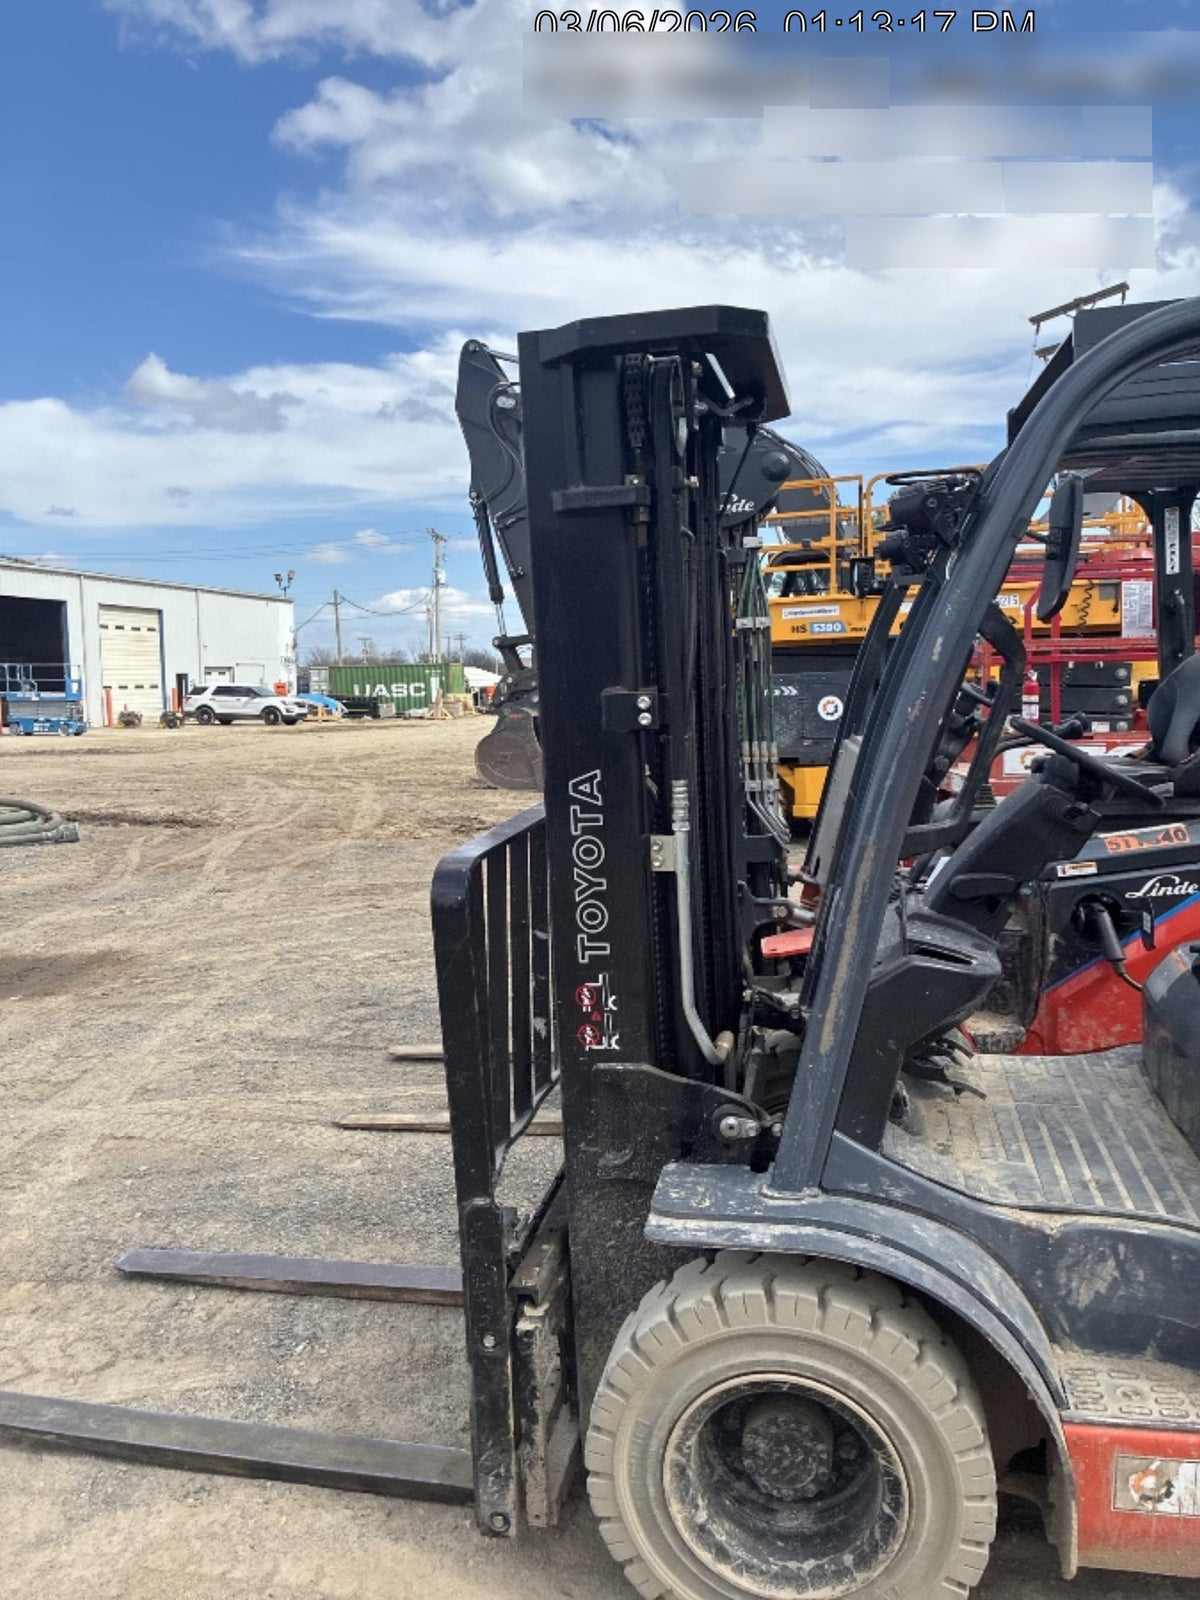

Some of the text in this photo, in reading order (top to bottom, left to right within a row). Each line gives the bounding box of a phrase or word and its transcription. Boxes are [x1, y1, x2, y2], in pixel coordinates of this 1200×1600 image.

[790, 623, 808, 634] HS
[353, 681, 426, 698] UASC
[568, 768, 611, 964] TOYOTA
[1124, 874, 1200, 899] Linde
